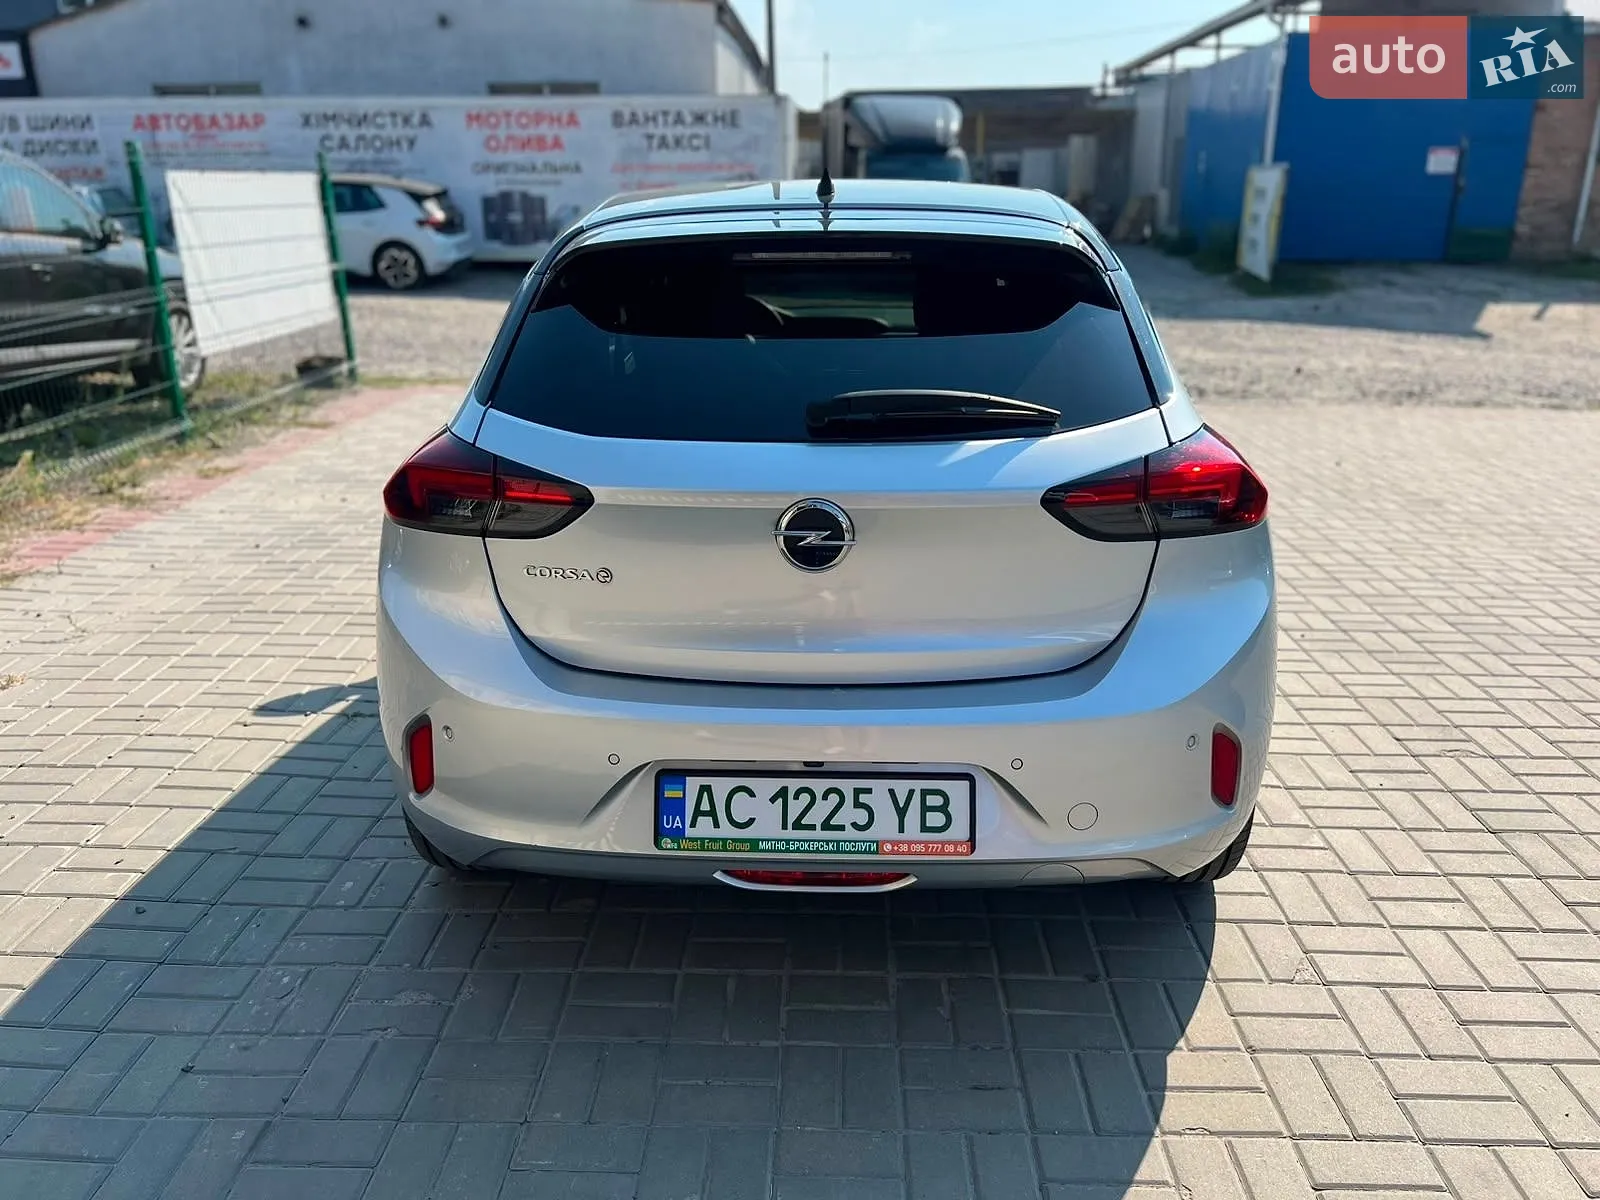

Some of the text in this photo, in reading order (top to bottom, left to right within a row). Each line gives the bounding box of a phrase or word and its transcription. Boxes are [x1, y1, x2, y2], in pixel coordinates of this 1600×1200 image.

[25, 113, 96, 133] ШИНИ
[133, 112, 266, 131] АВТОБАЗАР
[300, 111, 434, 130] ХІМЧИСТКА
[465, 110, 581, 129] МОТОРНА
[611, 109, 741, 128] ВАНТАЖНЕ
[22, 138, 101, 158] ДИСКИ
[319, 133, 418, 153] САЛОНУ
[483, 133, 566, 153] ОЛИВА
[644, 133, 711, 152] ТАКСІ
[689, 784, 953, 834] AC 1225 YB
[663, 815, 683, 829] UA
[679, 839, 701, 850] West
[704, 840, 723, 850] Fruit
[726, 840, 750, 851] Group
[758, 840, 877, 852] МИТНО-БРОКЕРСЬКІ ПОСЛУГИ
[892, 843, 967, 853] +38 095 777 08 40
